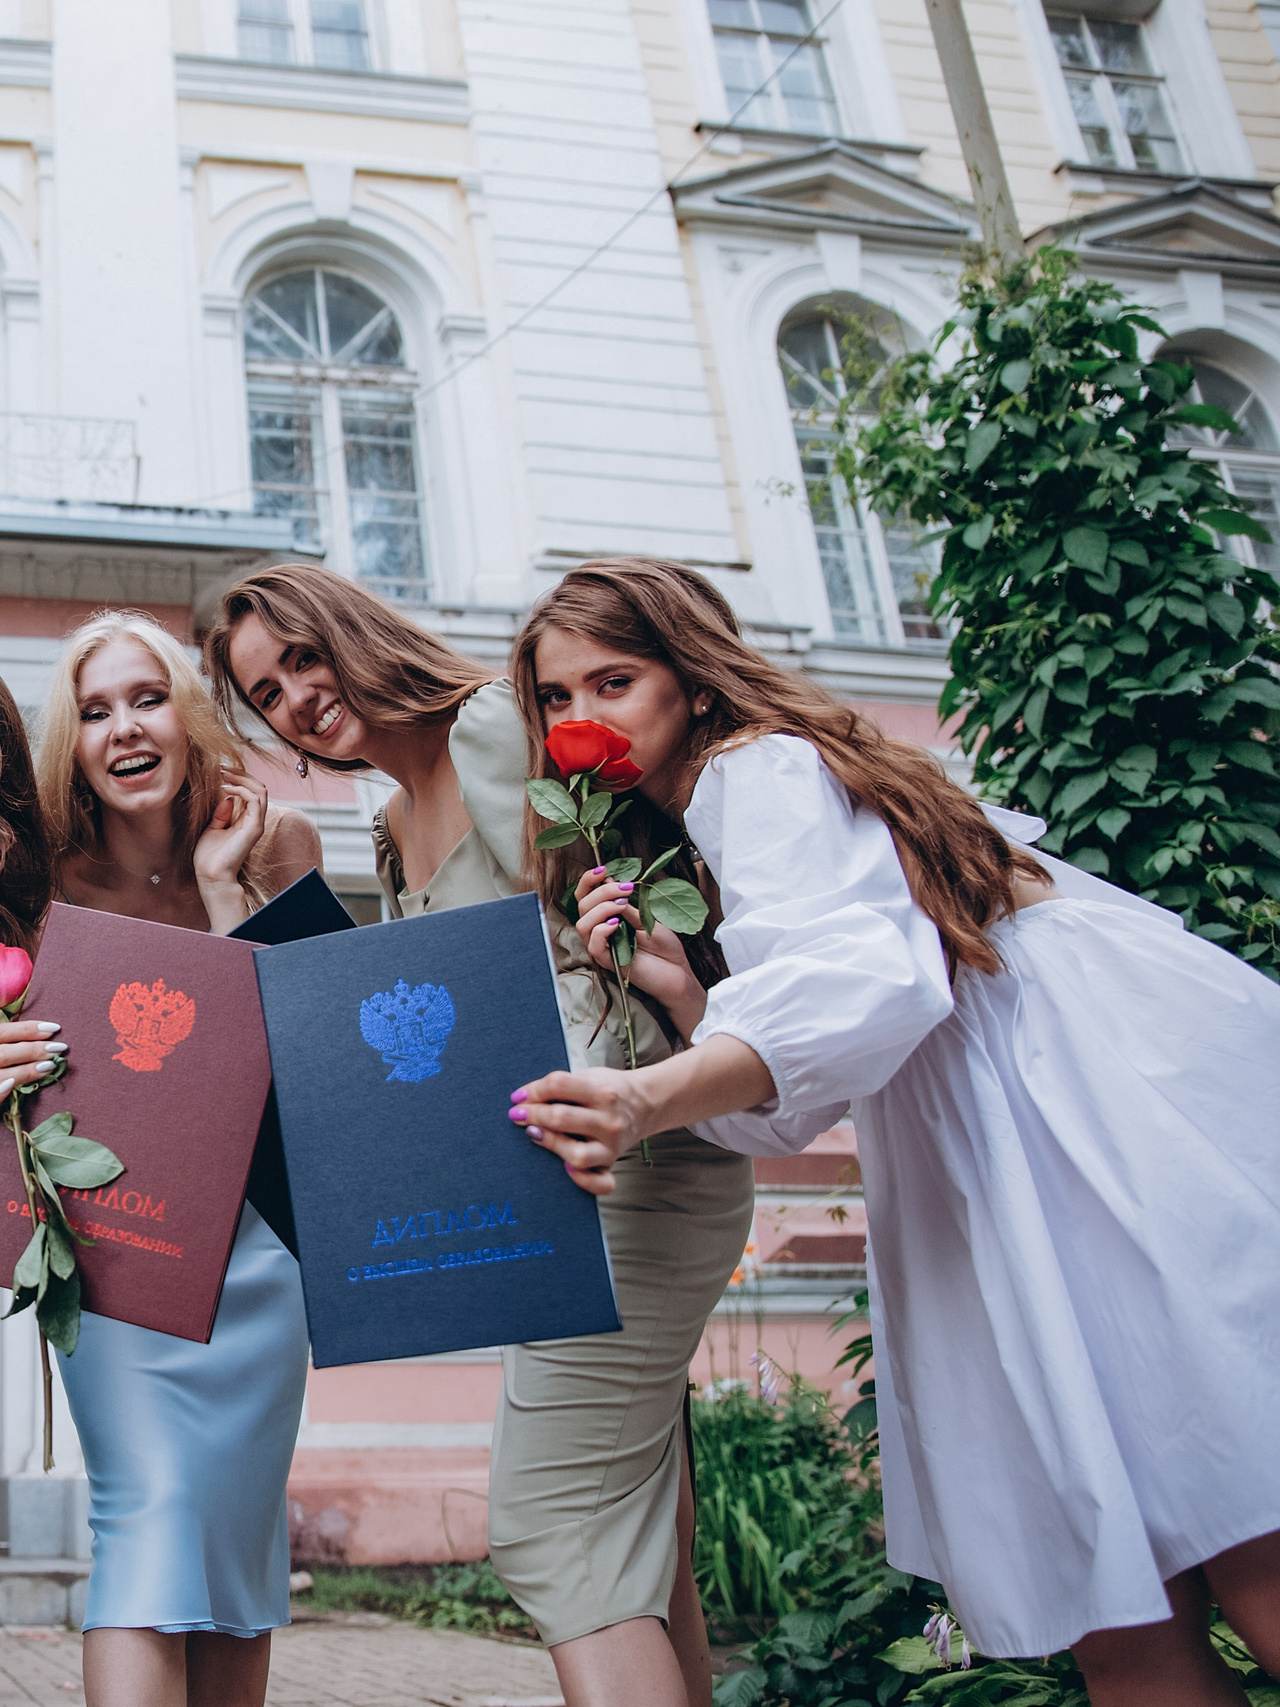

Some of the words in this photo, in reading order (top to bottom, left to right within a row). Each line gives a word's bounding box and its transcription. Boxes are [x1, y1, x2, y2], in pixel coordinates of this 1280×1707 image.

[6, 1200, 19, 1214] О
[83, 1221, 183, 1259] ОБРАЗОВАНИИ
[371, 1201, 517, 1249] ДИПЛОМ
[346, 1267, 360, 1283] О
